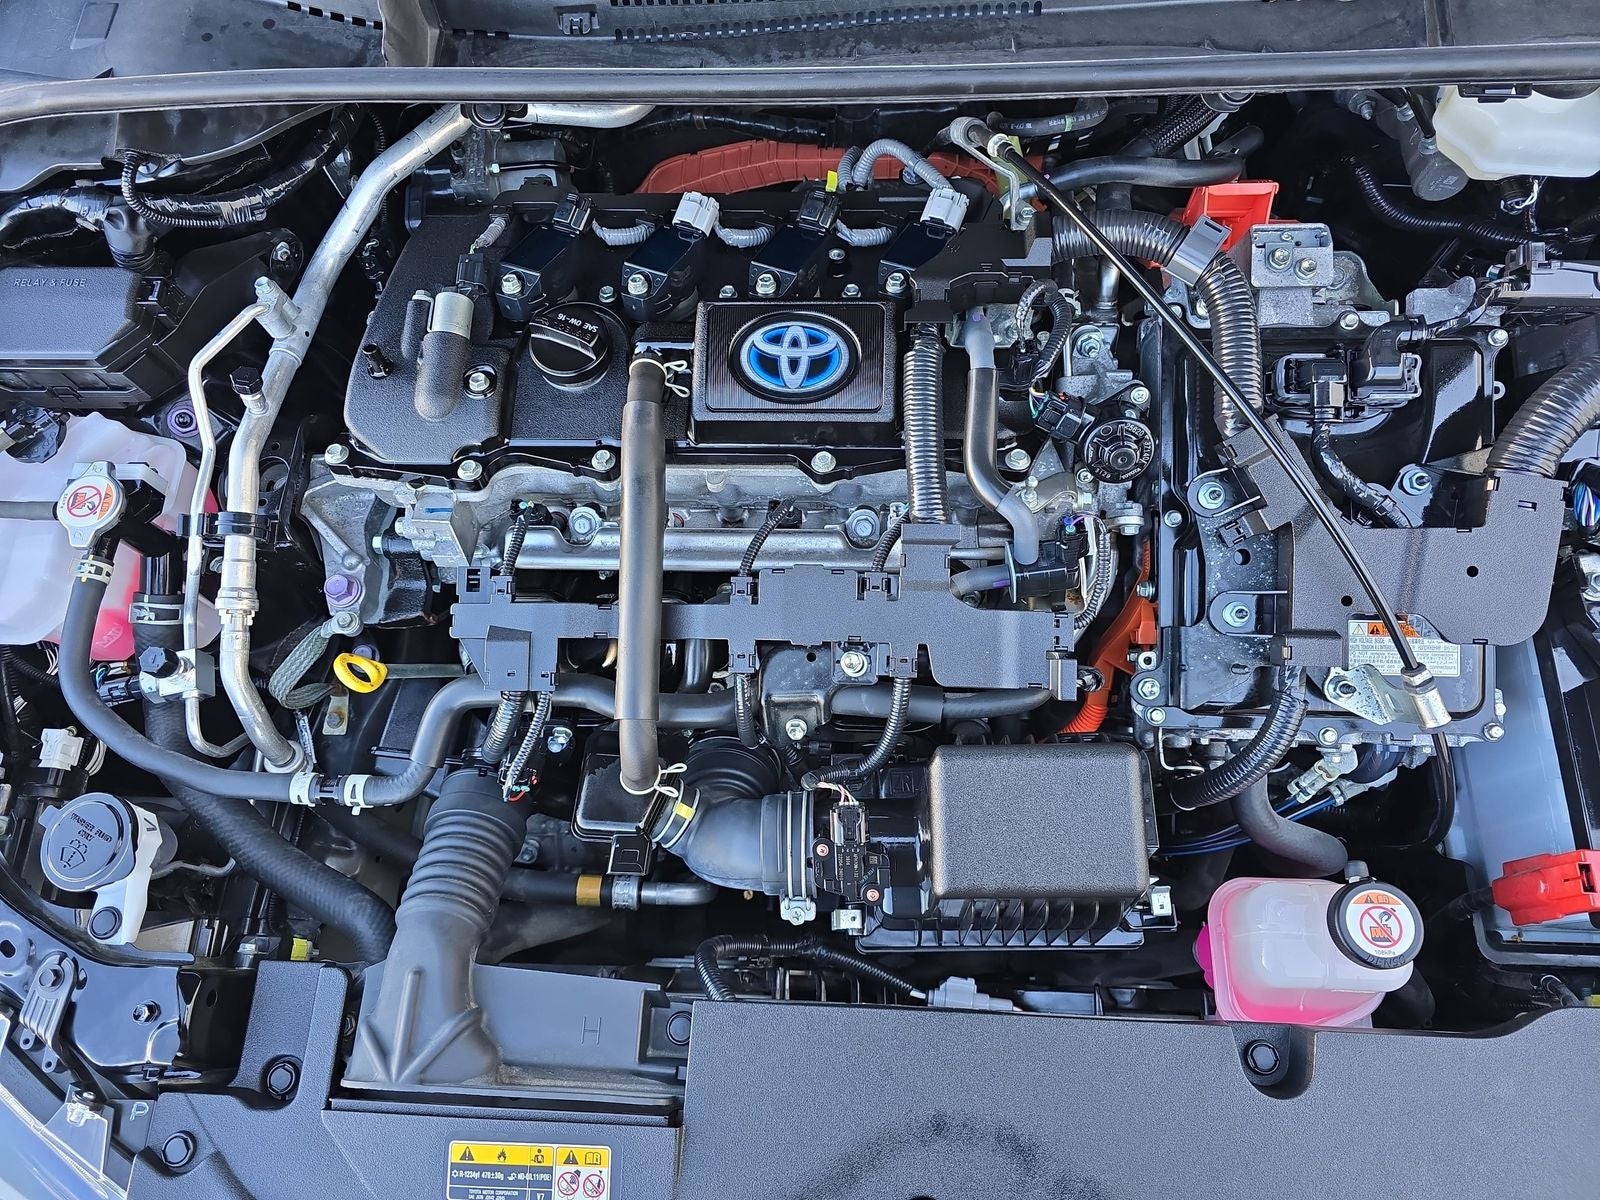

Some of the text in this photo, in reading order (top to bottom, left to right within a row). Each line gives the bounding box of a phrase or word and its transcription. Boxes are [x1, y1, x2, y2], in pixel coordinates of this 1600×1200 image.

[14, 278, 87, 287] RELAY & FUSE
[557, 313, 582, 327] 0W-16
[582, 322, 599, 333] SAE
[71, 812, 113, 843] WASHER FLUID
[78, 829, 96, 842] ONLY
[1366, 954, 1406, 968] DENSO
